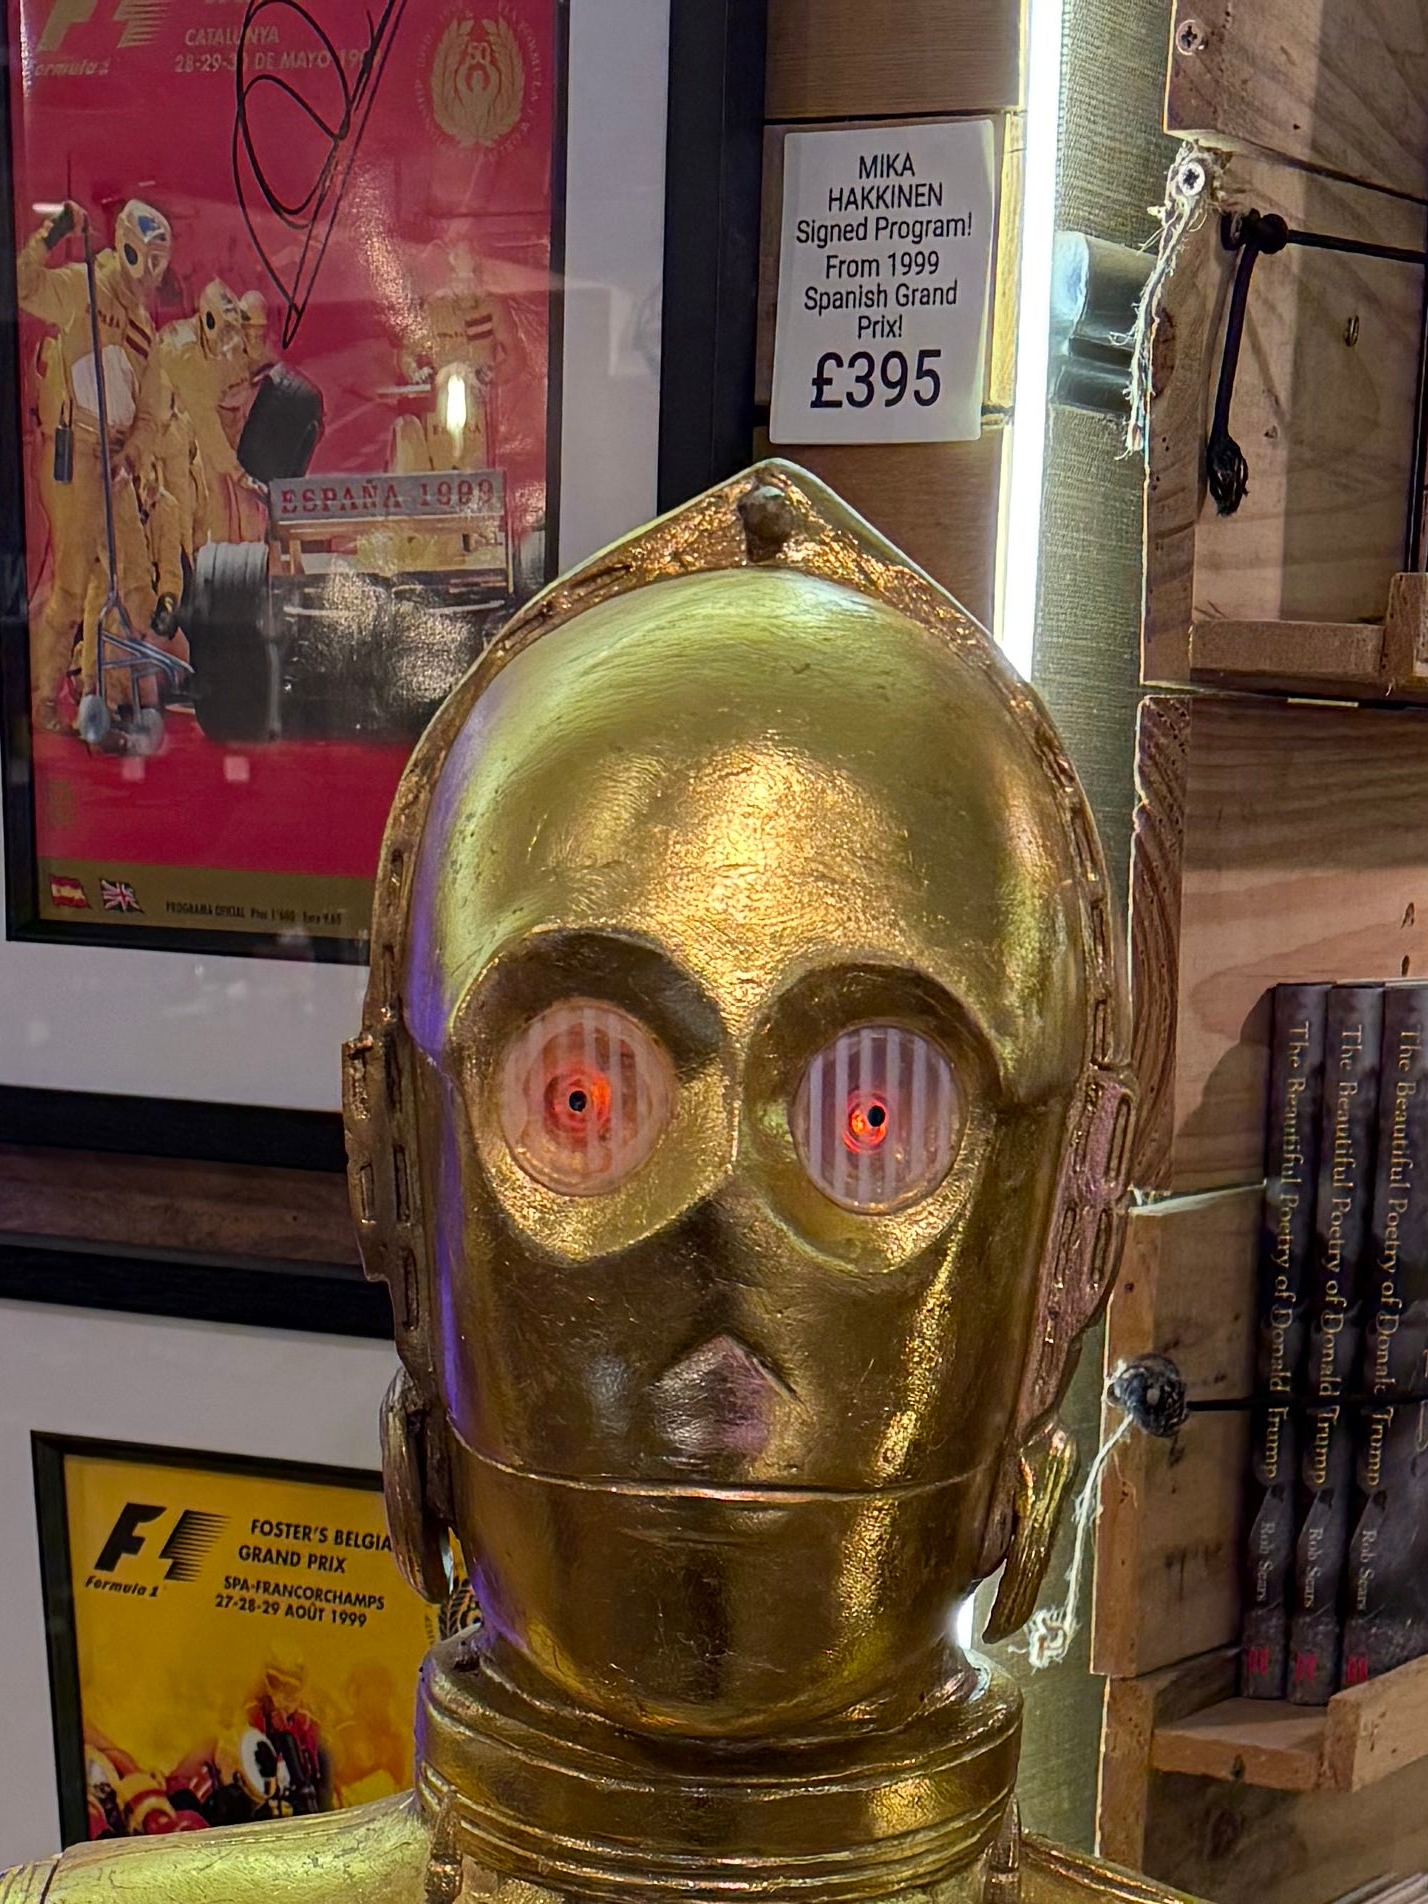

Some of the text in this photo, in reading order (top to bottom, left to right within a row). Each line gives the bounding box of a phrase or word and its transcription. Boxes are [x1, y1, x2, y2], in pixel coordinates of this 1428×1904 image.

[184, 25, 280, 47] CATALUNYA
[255, 52, 275, 70] DE
[279, 51, 332, 69] MAYO
[858, 152, 916, 180] MIKA
[828, 182, 943, 212] HAKKINEN
[796, 212, 973, 249] Signed Program!
[825, 250, 940, 280] From 1999
[804, 280, 958, 316] Spanish Grand
[857, 314, 904, 340] Prix!
[809, 348, 942, 409] £395
[280, 478, 495, 515] ESPAÑA 1999
[1398, 1025, 1421, 1072] The
[1389, 1080, 1417, 1192] Beautiful
[1264, 1021, 1310, 1480] The Beautiful Poetry of Donald Trump
[1313, 1023, 1362, 1485] The Beautiful Poetry of Donald Trump
[1376, 1196, 1409, 1277] Poetry
[1381, 1279, 1403, 1312] of
[1367, 1404, 1394, 1487] Trump
[93, 1502, 233, 1583] F1
[249, 1518, 329, 1544] FOSTER'S
[1260, 1521, 1276, 1555] Rob
[237, 1544, 348, 1575] GRAND PRIX
[1304, 1526, 1324, 1609] Rob Sears
[1357, 1528, 1377, 1611] Rob Sears
[84, 1575, 160, 1598] Formula 1
[223, 1575, 386, 1611] SPA-FRANCORCHAMPS
[215, 1593, 369, 1629] 27-28-29 AOÛT 1999
